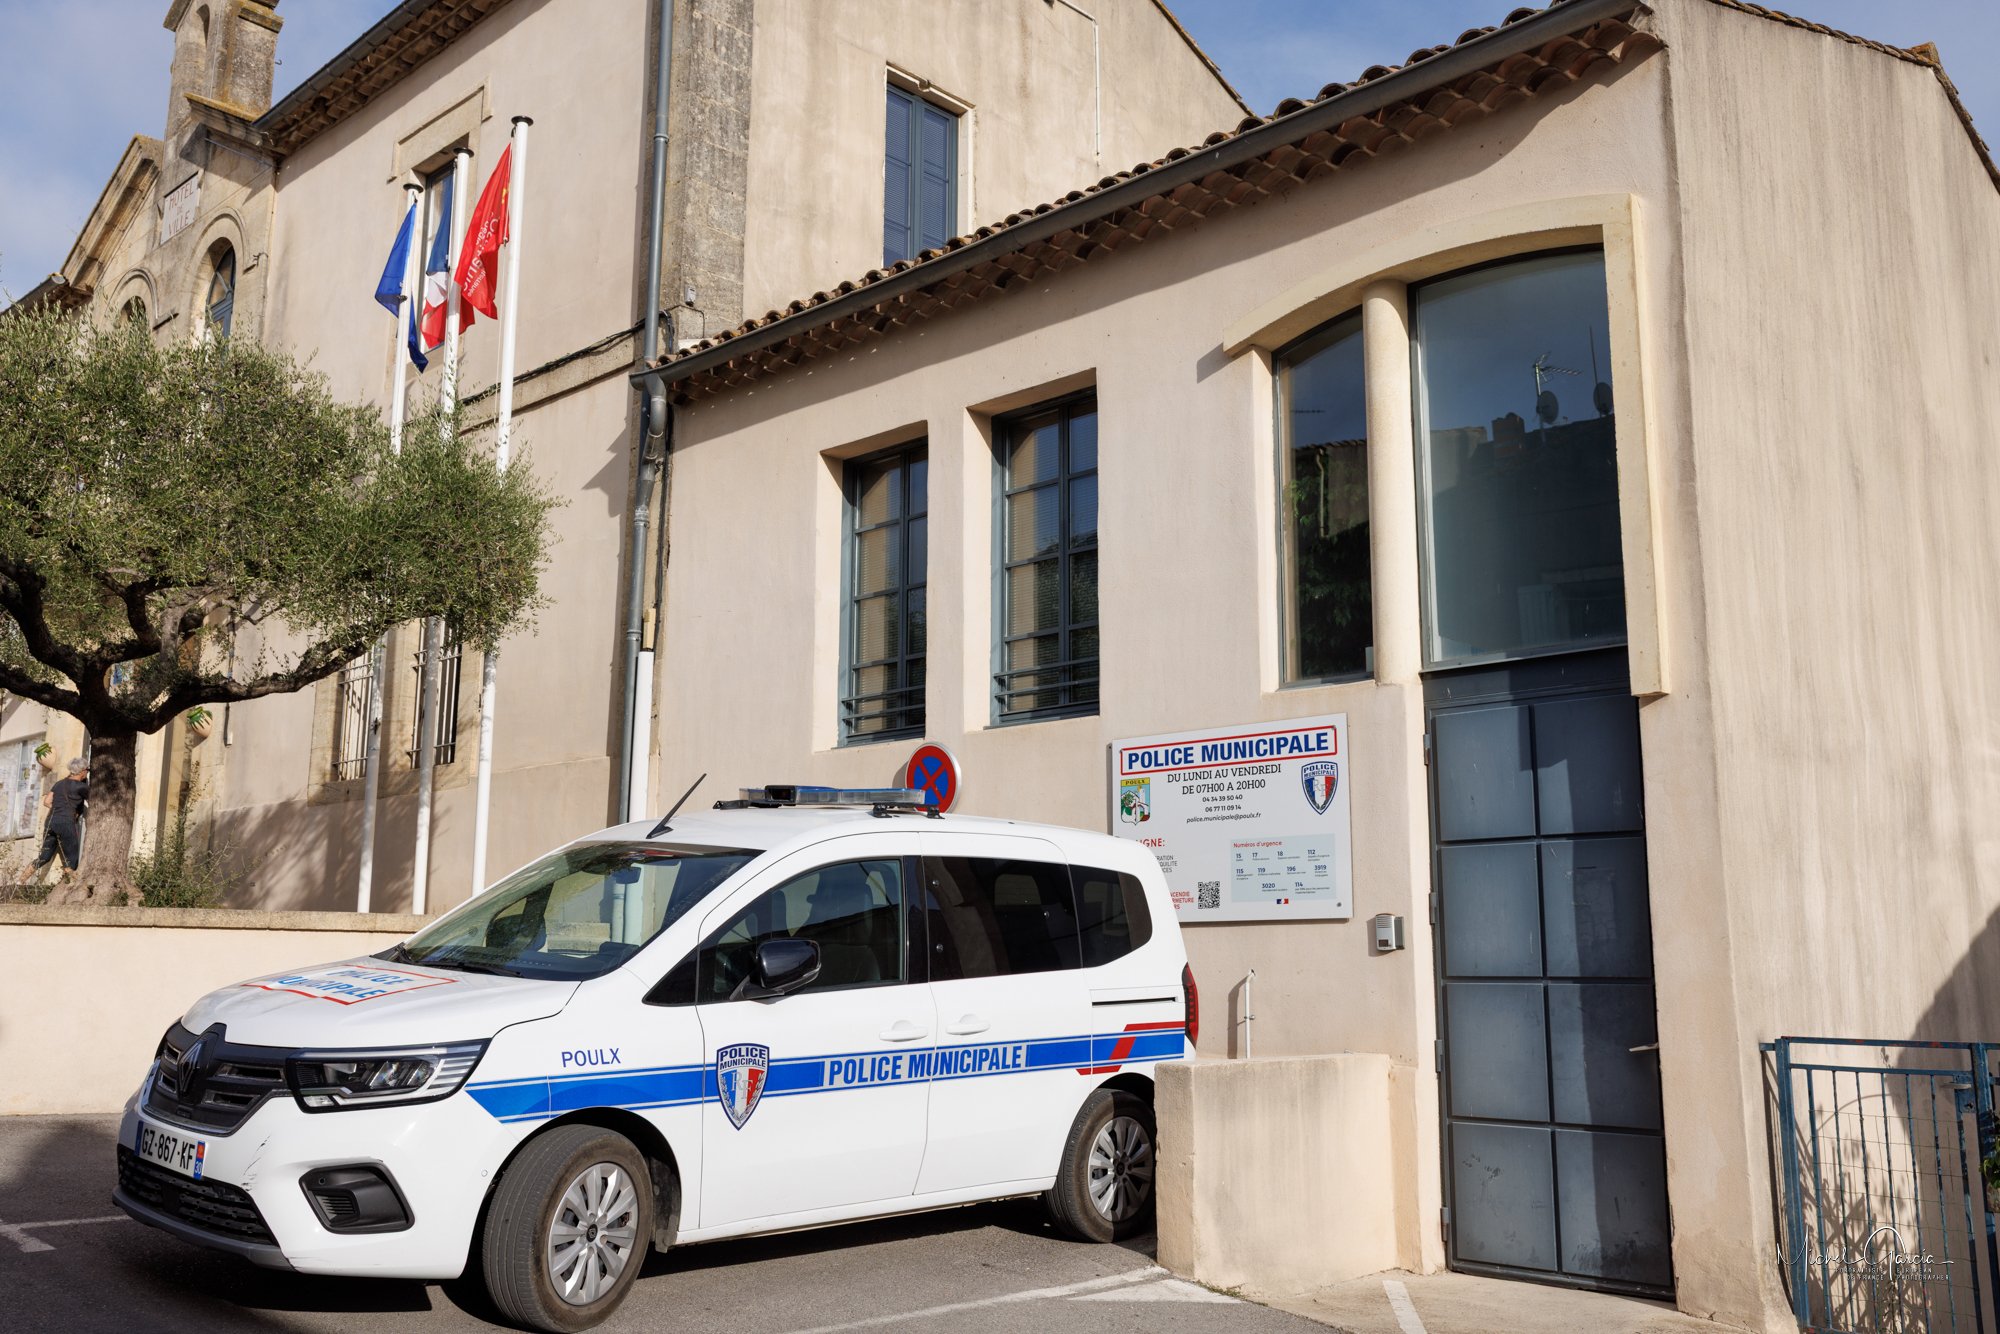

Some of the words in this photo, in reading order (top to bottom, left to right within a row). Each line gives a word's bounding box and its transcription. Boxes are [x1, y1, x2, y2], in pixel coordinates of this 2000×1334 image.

[169, 210, 190, 236] VILLE
[1128, 746, 1194, 770] POLICE
[1201, 732, 1329, 763] MUNICIPALE
[1167, 773, 1180, 783] DU
[1183, 770, 1212, 782] LUNDI
[1214, 768, 1229, 779] AU
[1231, 763, 1281, 777] VENDREDI
[1303, 763, 1336, 773] POLICE
[1303, 770, 1336, 778] MUNICIPALE
[1182, 785, 1194, 795] DE
[1196, 782, 1225, 794] 07H00
[1227, 782, 1234, 791] A
[1236, 779, 1266, 790] 20H00
[1186, 812, 1261, 824] police.municipale@poulx.fr
[1139, 837, 1165, 848] GNE:
[1256, 840, 1283, 848] d'urgence
[561, 1048, 621, 1068] POULX
[720, 1047, 766, 1062] POLICE
[720, 1058, 766, 1070] MUNICIPALE
[829, 1056, 903, 1086] POLICE
[908, 1046, 1022, 1078] MUNICIPALE
[142, 1128, 195, 1170] GZ-867-KF
[195, 1161, 203, 1175] 30
